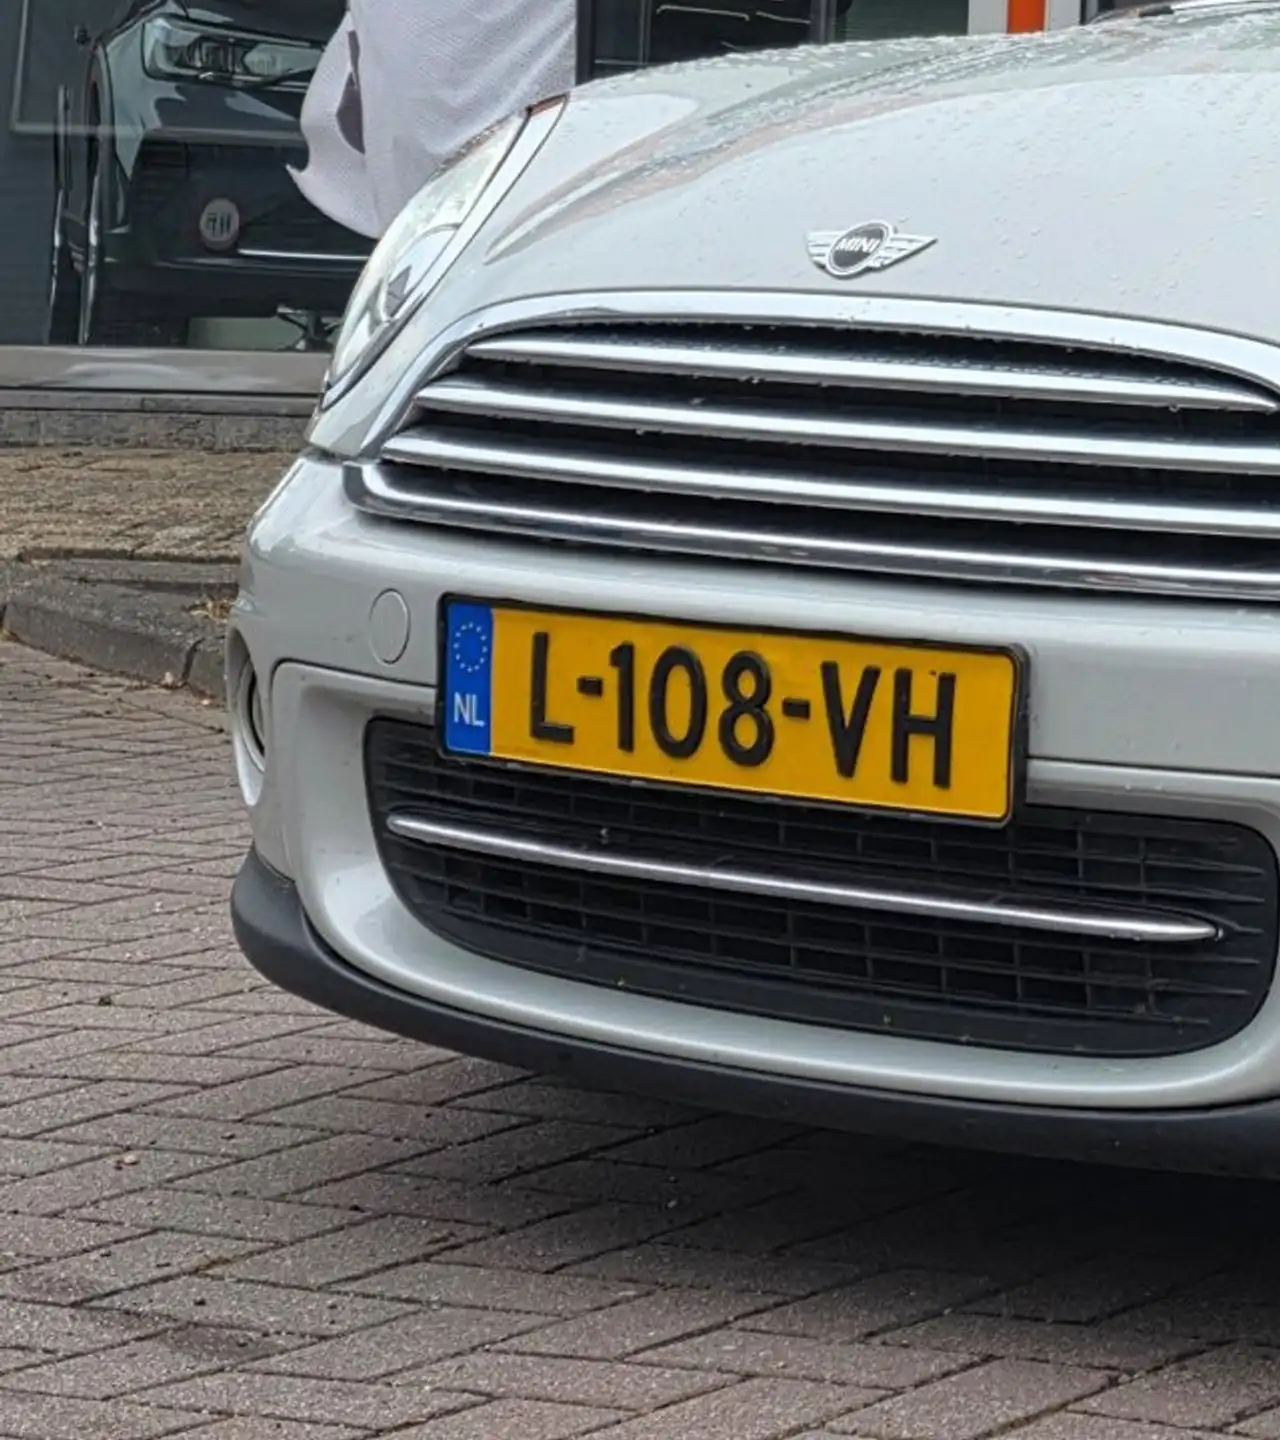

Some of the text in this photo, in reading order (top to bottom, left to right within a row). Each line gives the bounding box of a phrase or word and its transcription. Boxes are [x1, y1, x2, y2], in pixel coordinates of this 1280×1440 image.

[837, 237, 880, 253] MINI
[453, 691, 485, 728] NL
[529, 632, 957, 789] L-108-VH
